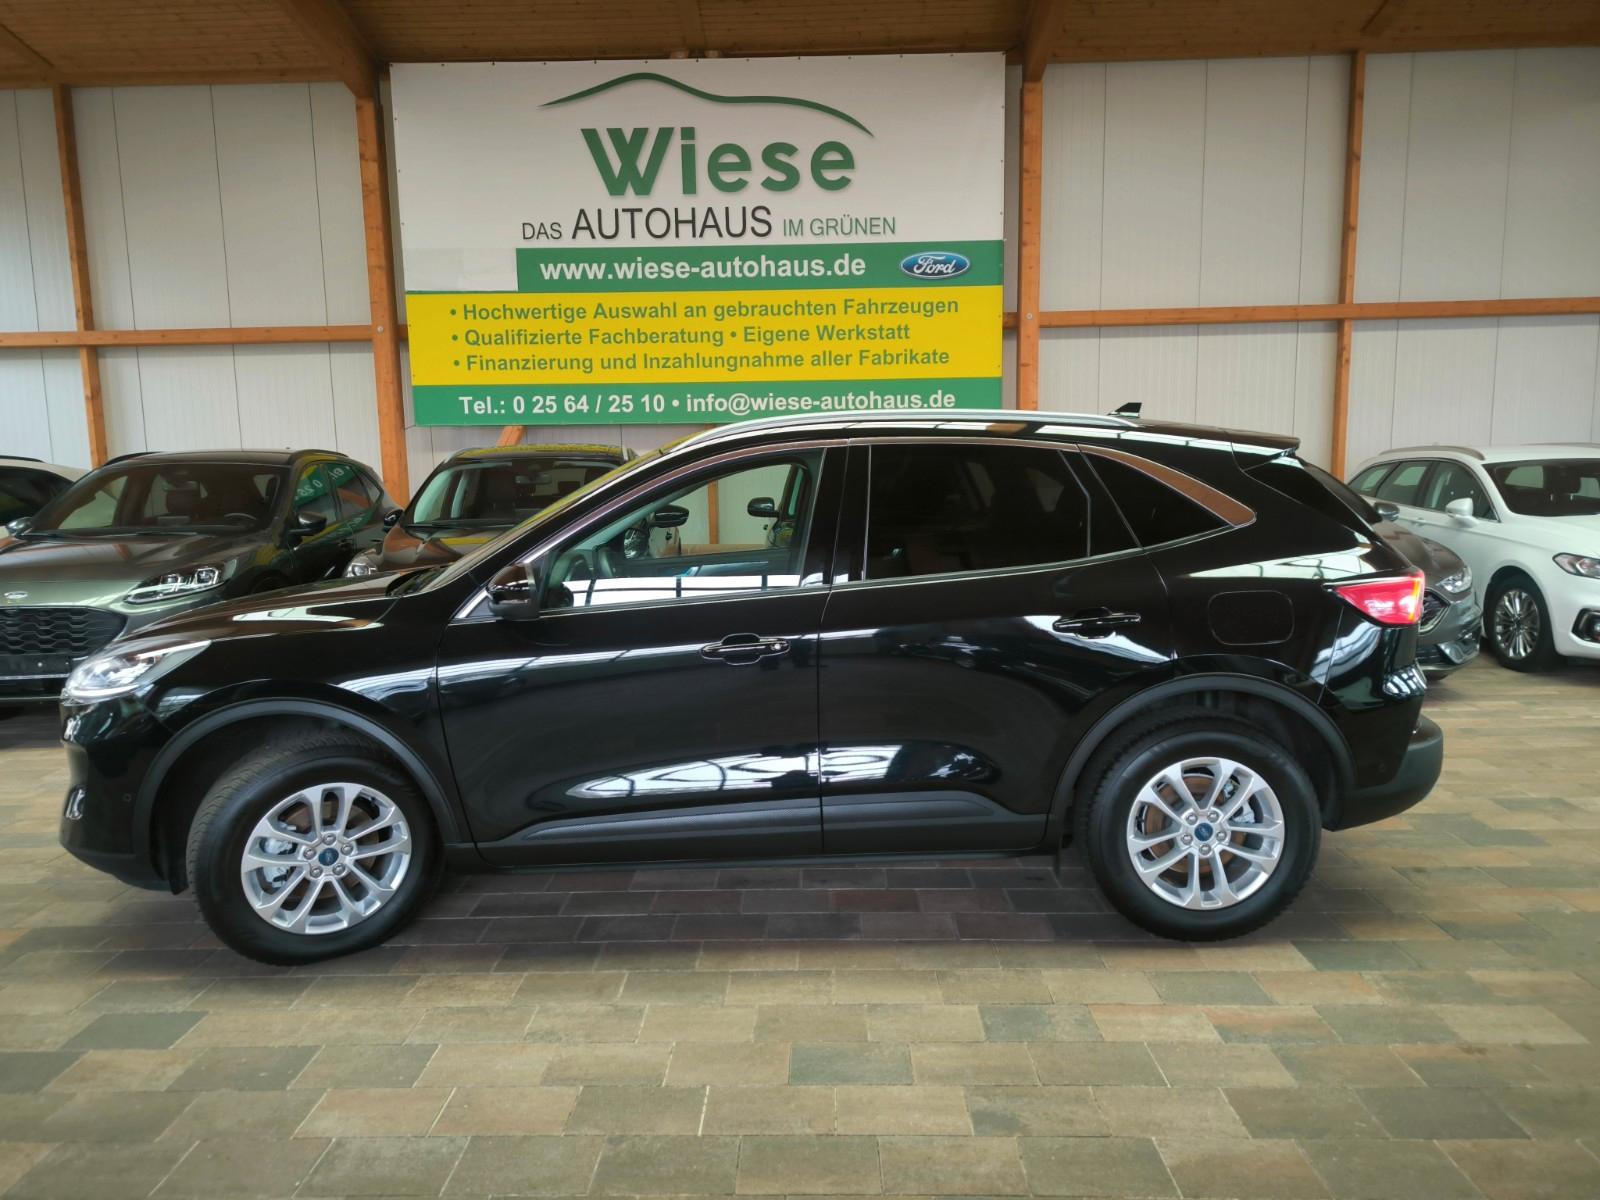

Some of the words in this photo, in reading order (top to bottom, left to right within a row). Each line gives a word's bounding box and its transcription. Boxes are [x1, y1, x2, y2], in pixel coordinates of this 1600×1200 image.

[580, 126, 856, 197] Wiese
[521, 222, 563, 240] DAS
[571, 205, 773, 241] AUTOHAUS
[782, 218, 804, 237] IM
[809, 213, 897, 237] GRÜNEN
[539, 252, 867, 281] www.wiese-autohaus.de
[462, 303, 588, 324] Hochwertige
[592, 301, 678, 320] Auswahl
[683, 303, 708, 319] an
[713, 299, 837, 321] gebrauchten
[843, 298, 960, 318] Fahrzeugen
[464, 328, 583, 347] Qualifizierte
[588, 327, 725, 348] Fachberatung
[743, 325, 811, 346] Eigene
[816, 323, 911, 342] Werkstatt
[466, 353, 594, 374] Finanzierung
[600, 353, 638, 370] und
[643, 351, 805, 373] Inzahlungnahme
[810, 350, 853, 368] aller
[859, 347, 951, 366] Fabrikate
[458, 396, 506, 415] Tel.:
[512, 395, 525, 414] 0
[531, 395, 558, 414] 25
[563, 394, 590, 414] 64
[607, 394, 634, 413] 25
[640, 393, 666, 413] 10
[686, 389, 957, 416] info@wiese-autohaus.de
